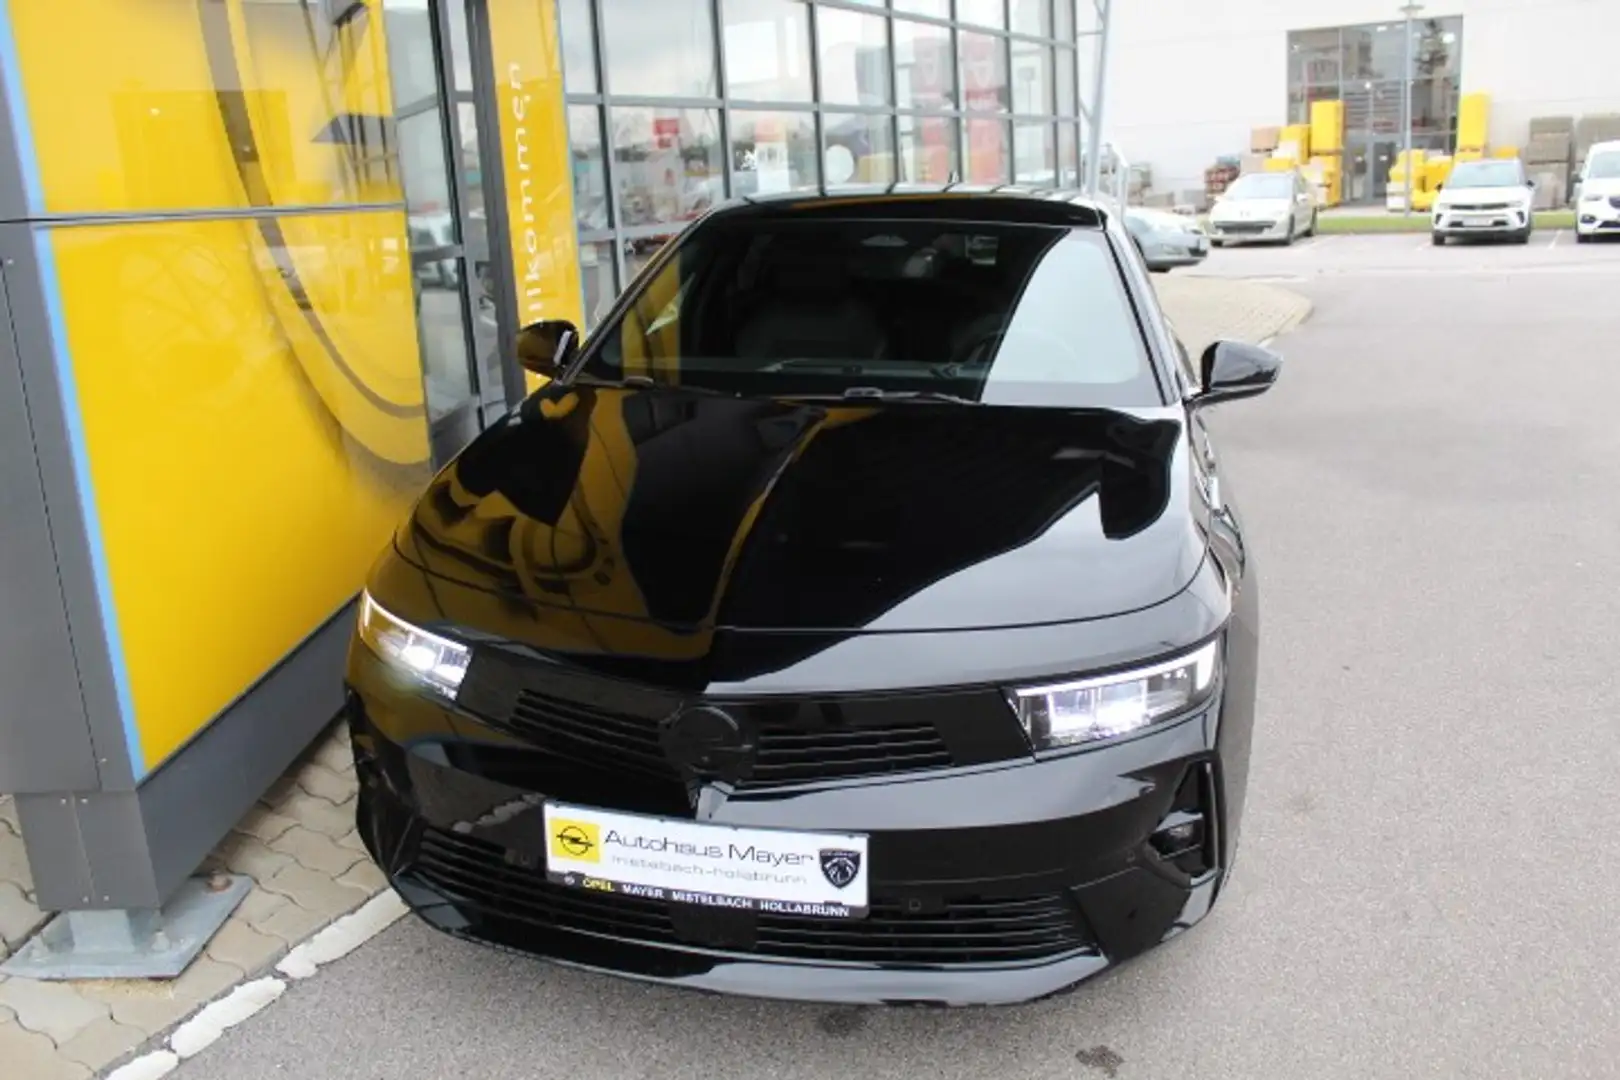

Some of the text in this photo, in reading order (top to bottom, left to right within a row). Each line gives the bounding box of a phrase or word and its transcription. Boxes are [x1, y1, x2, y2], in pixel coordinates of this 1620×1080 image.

[604, 829, 814, 868] Autohaus Mayer
[582, 877, 850, 917] OPEL MAYER MISTELBACH HOLLABRUNN
